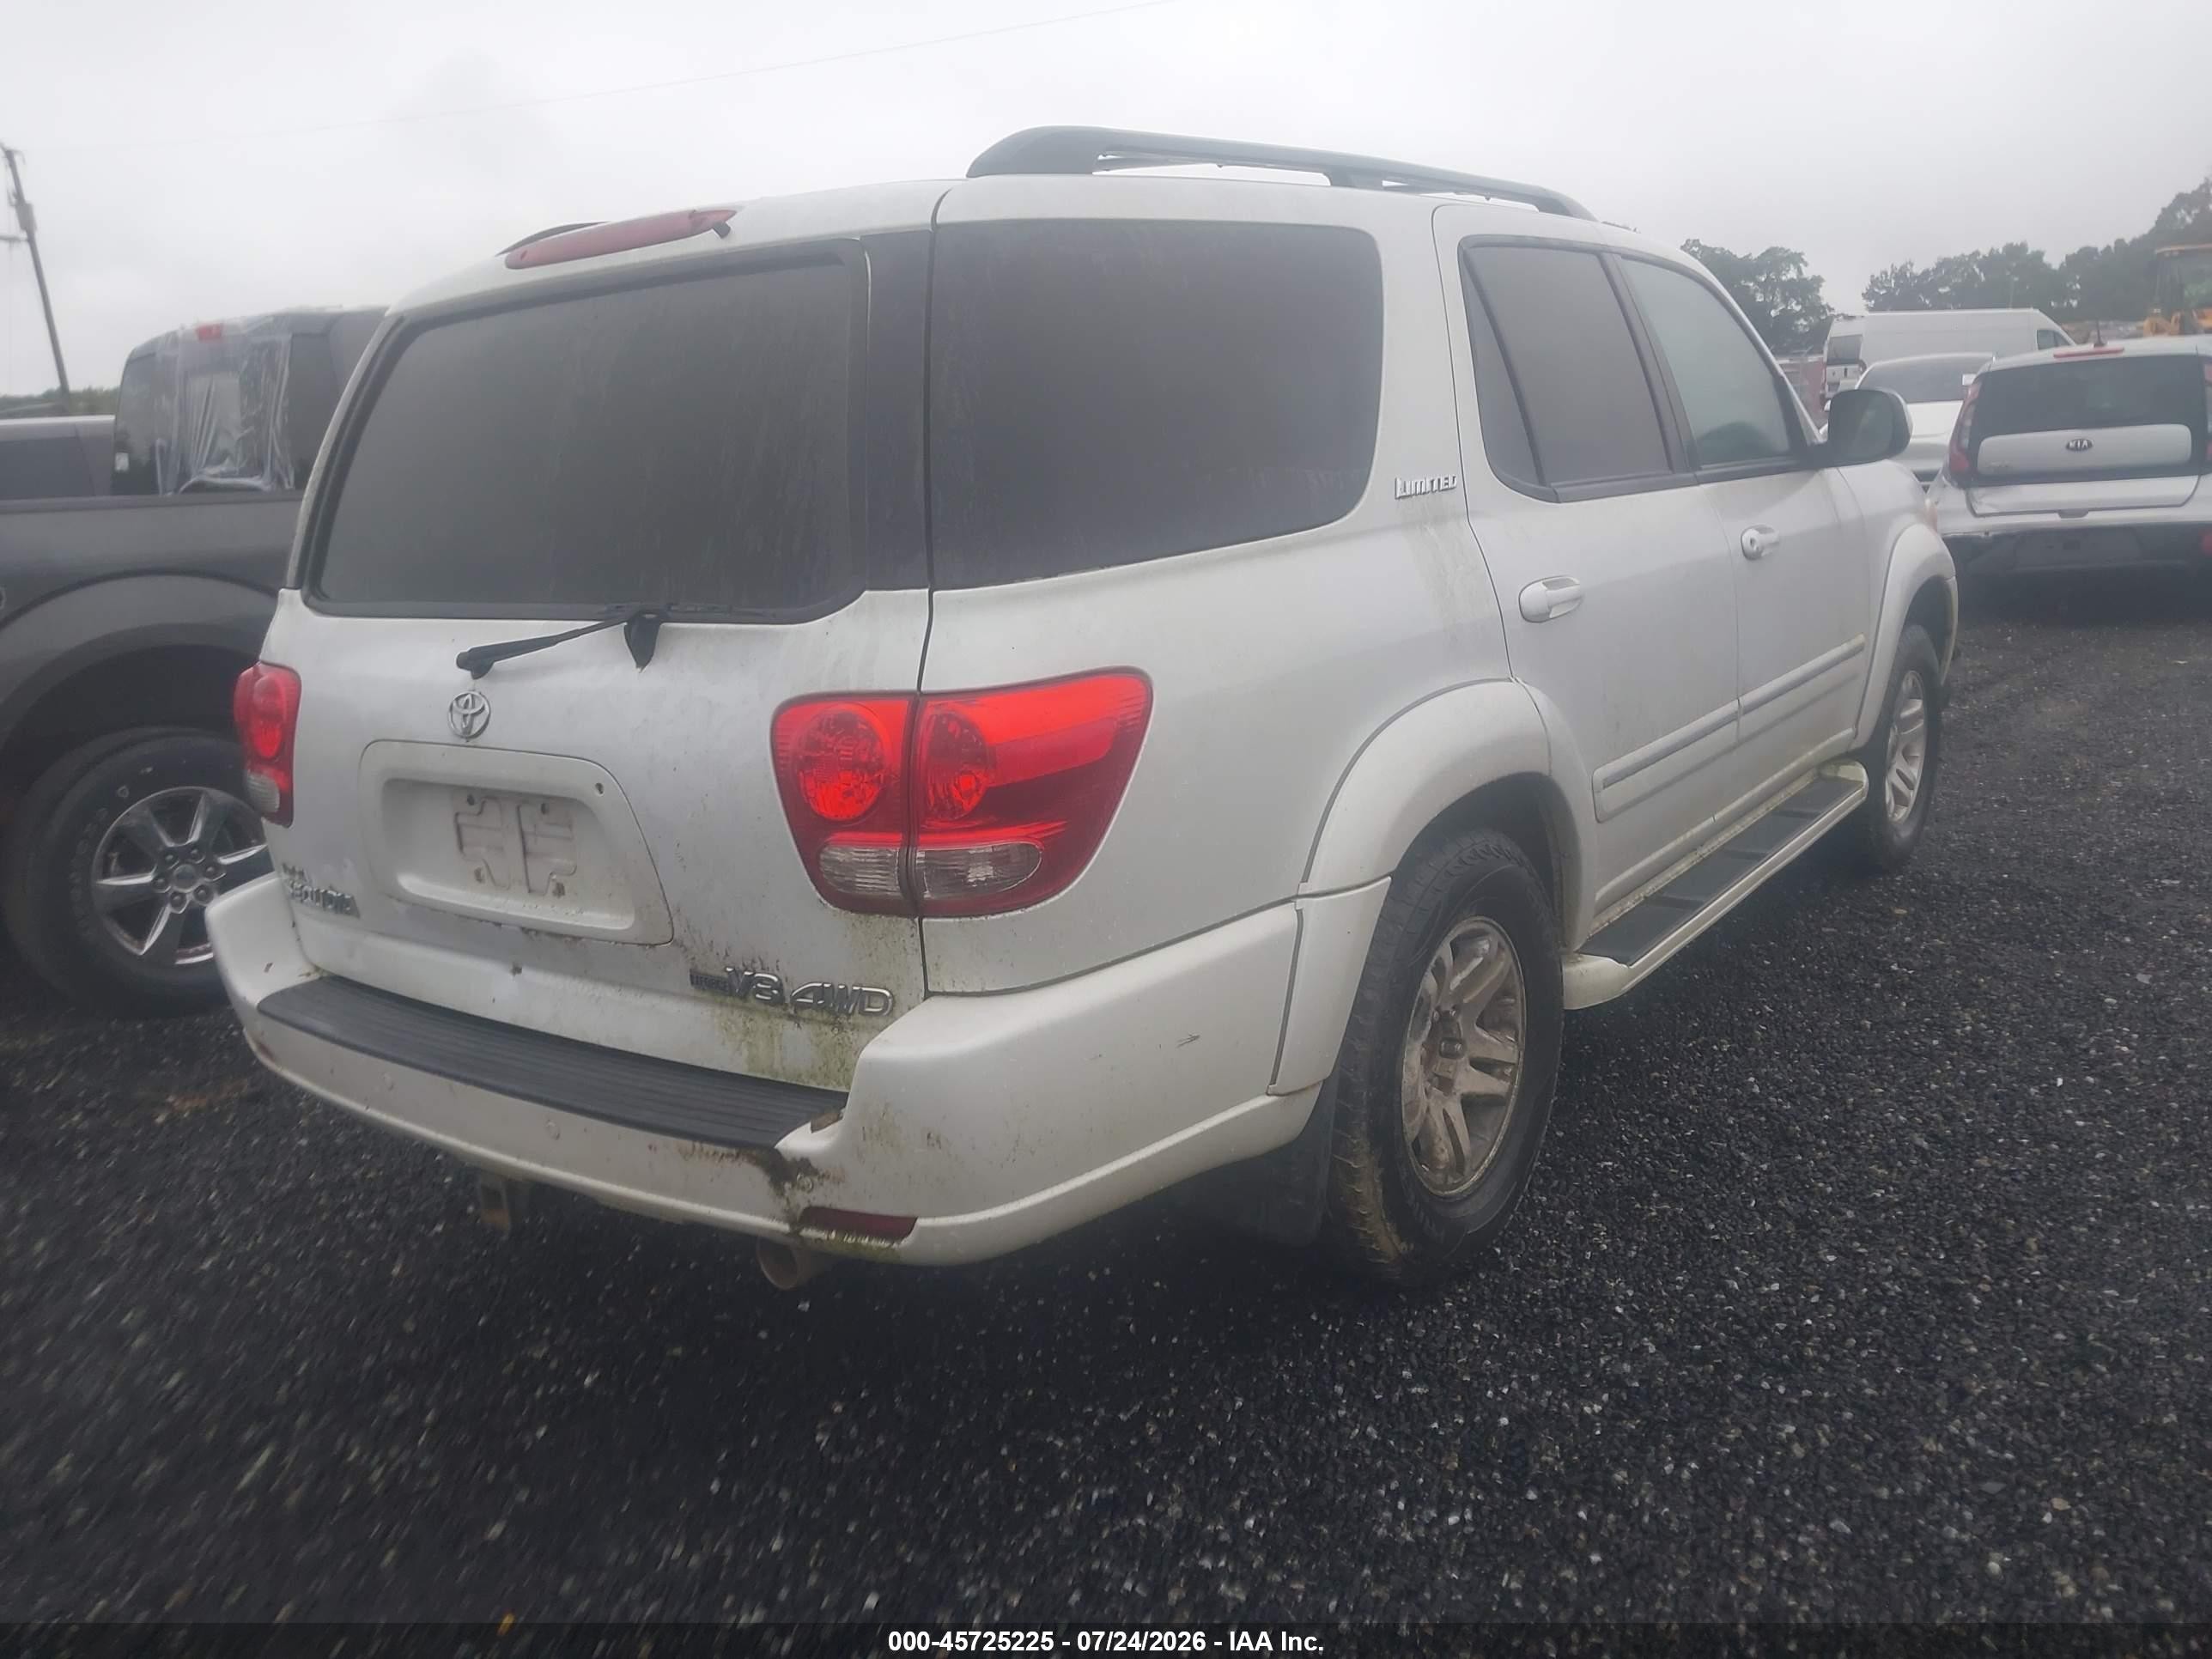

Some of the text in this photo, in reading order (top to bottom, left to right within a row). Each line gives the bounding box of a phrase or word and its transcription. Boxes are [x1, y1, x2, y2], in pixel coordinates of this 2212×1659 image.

[2069, 440, 2088, 448] KIA
[1395, 475, 1457, 499] LIMITED
[726, 966, 785, 1003] V8
[790, 981, 894, 1015] 4WD
